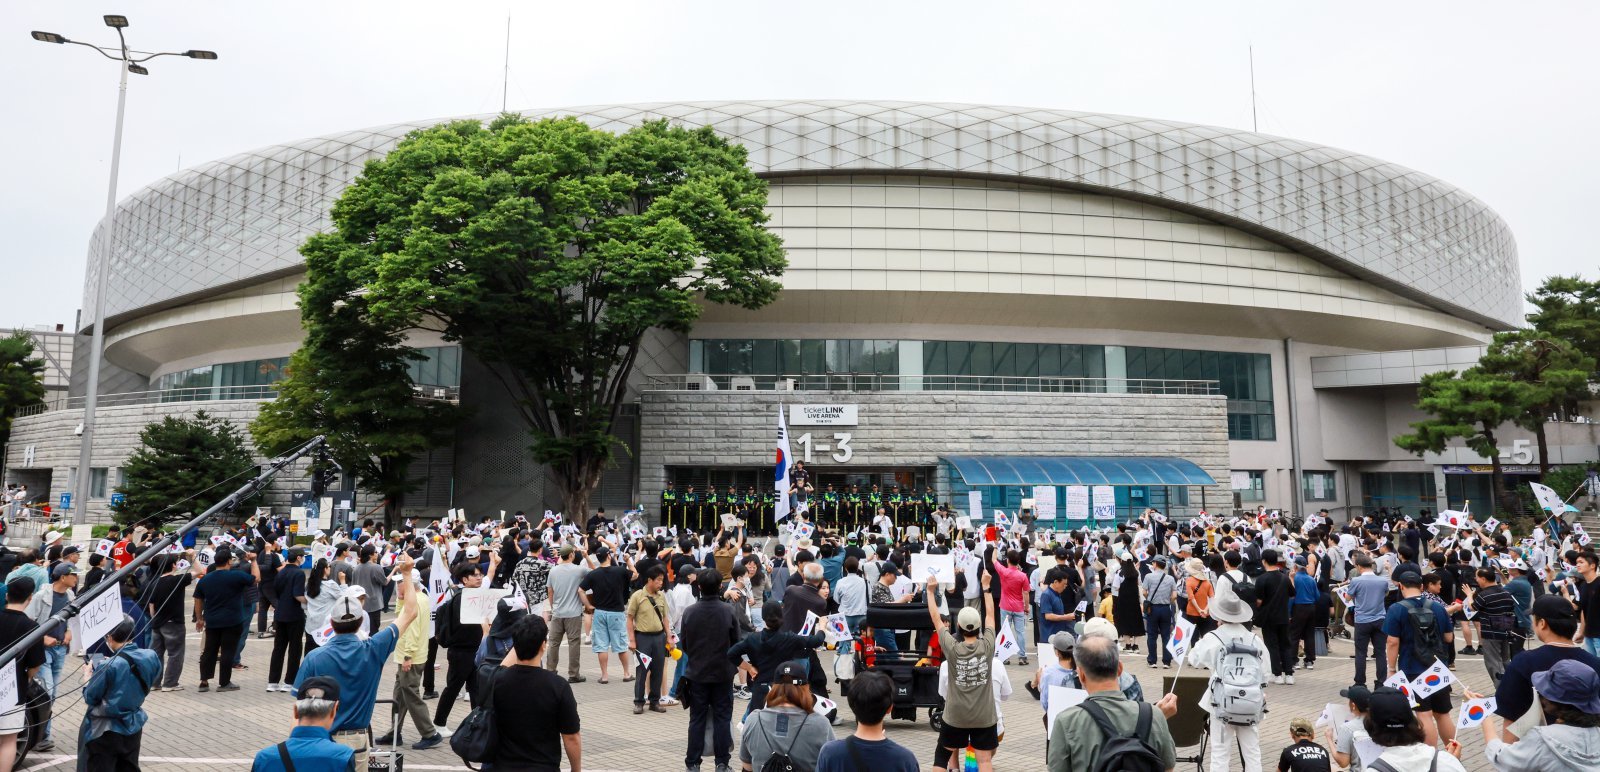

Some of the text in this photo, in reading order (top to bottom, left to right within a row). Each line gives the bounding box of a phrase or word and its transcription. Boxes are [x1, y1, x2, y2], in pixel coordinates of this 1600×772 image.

[797, 432, 853, 463] 1-3
[1490, 439, 1534, 465] -5
[80, 587, 120, 635] 재선거
[1291, 746, 1326, 757] KOREA
